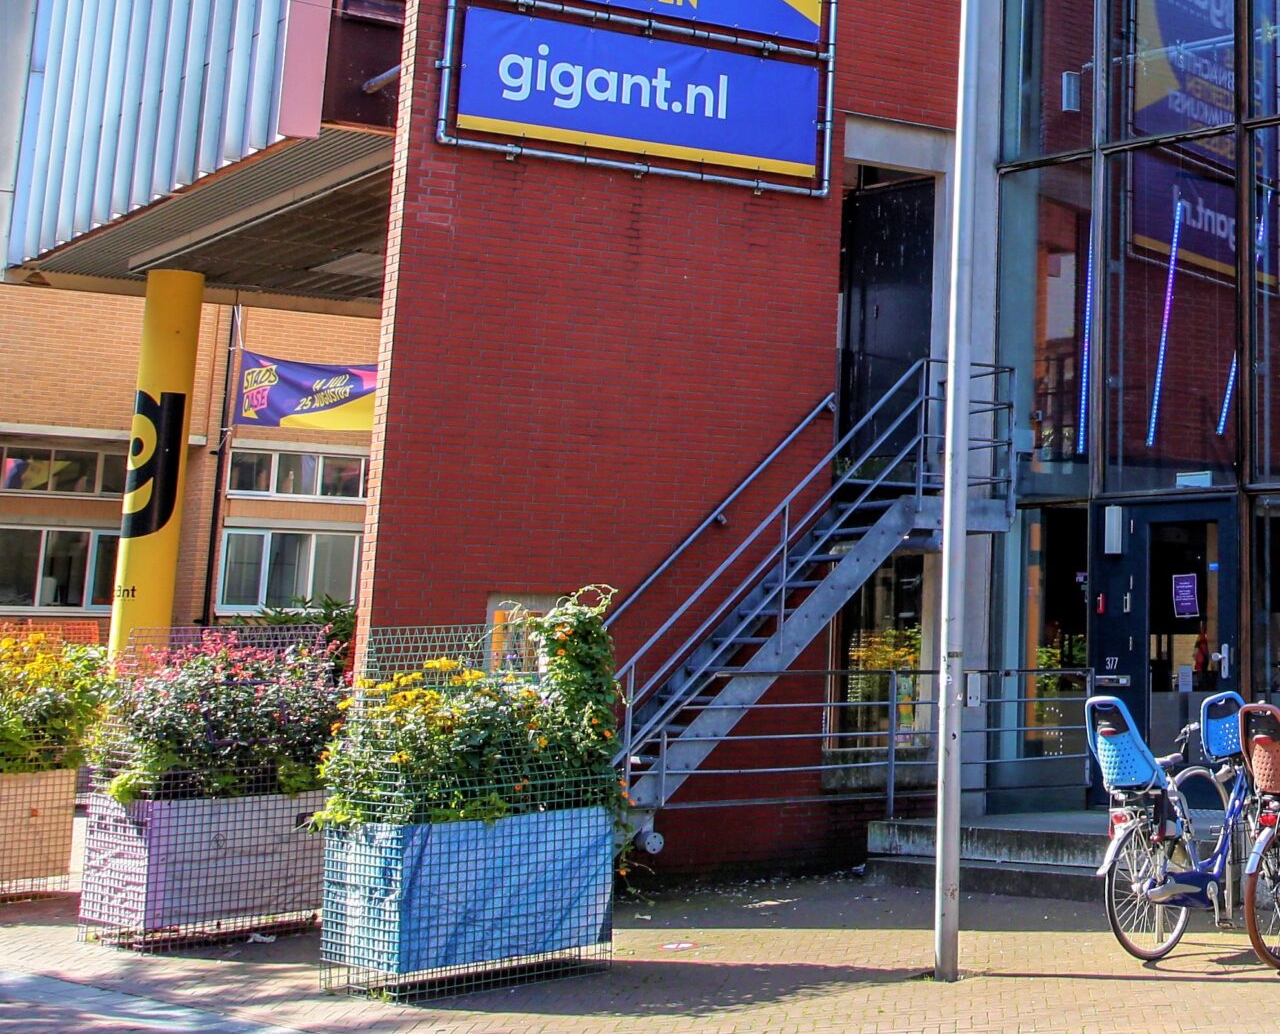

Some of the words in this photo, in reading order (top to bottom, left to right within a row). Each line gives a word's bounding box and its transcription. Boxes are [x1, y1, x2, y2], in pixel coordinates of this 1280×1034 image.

[498, 42, 729, 121] gigant.nl
[244, 367, 279, 390] STADS
[294, 395, 313, 411] 25
[312, 384, 354, 408] AUGUSTUS
[1105, 656, 1119, 671] 377
